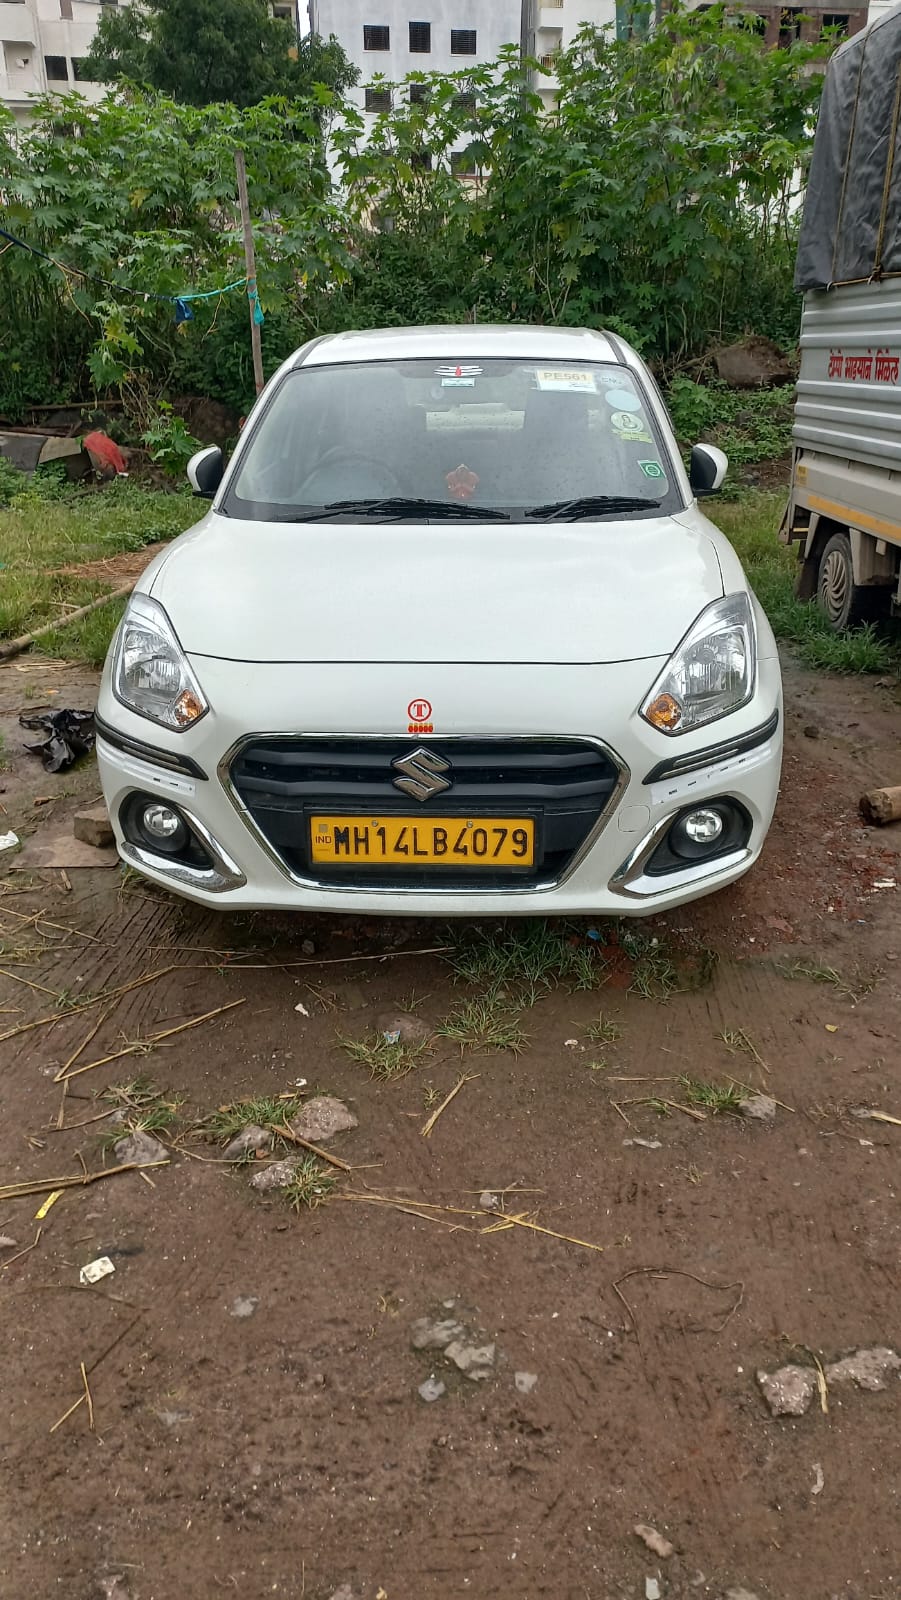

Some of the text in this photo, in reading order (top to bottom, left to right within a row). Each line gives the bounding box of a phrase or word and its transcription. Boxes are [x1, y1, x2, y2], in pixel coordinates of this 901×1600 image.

[543, 371, 587, 382] PE561
[315, 835, 332, 844] IND
[334, 826, 528, 857] MH14LB4079
